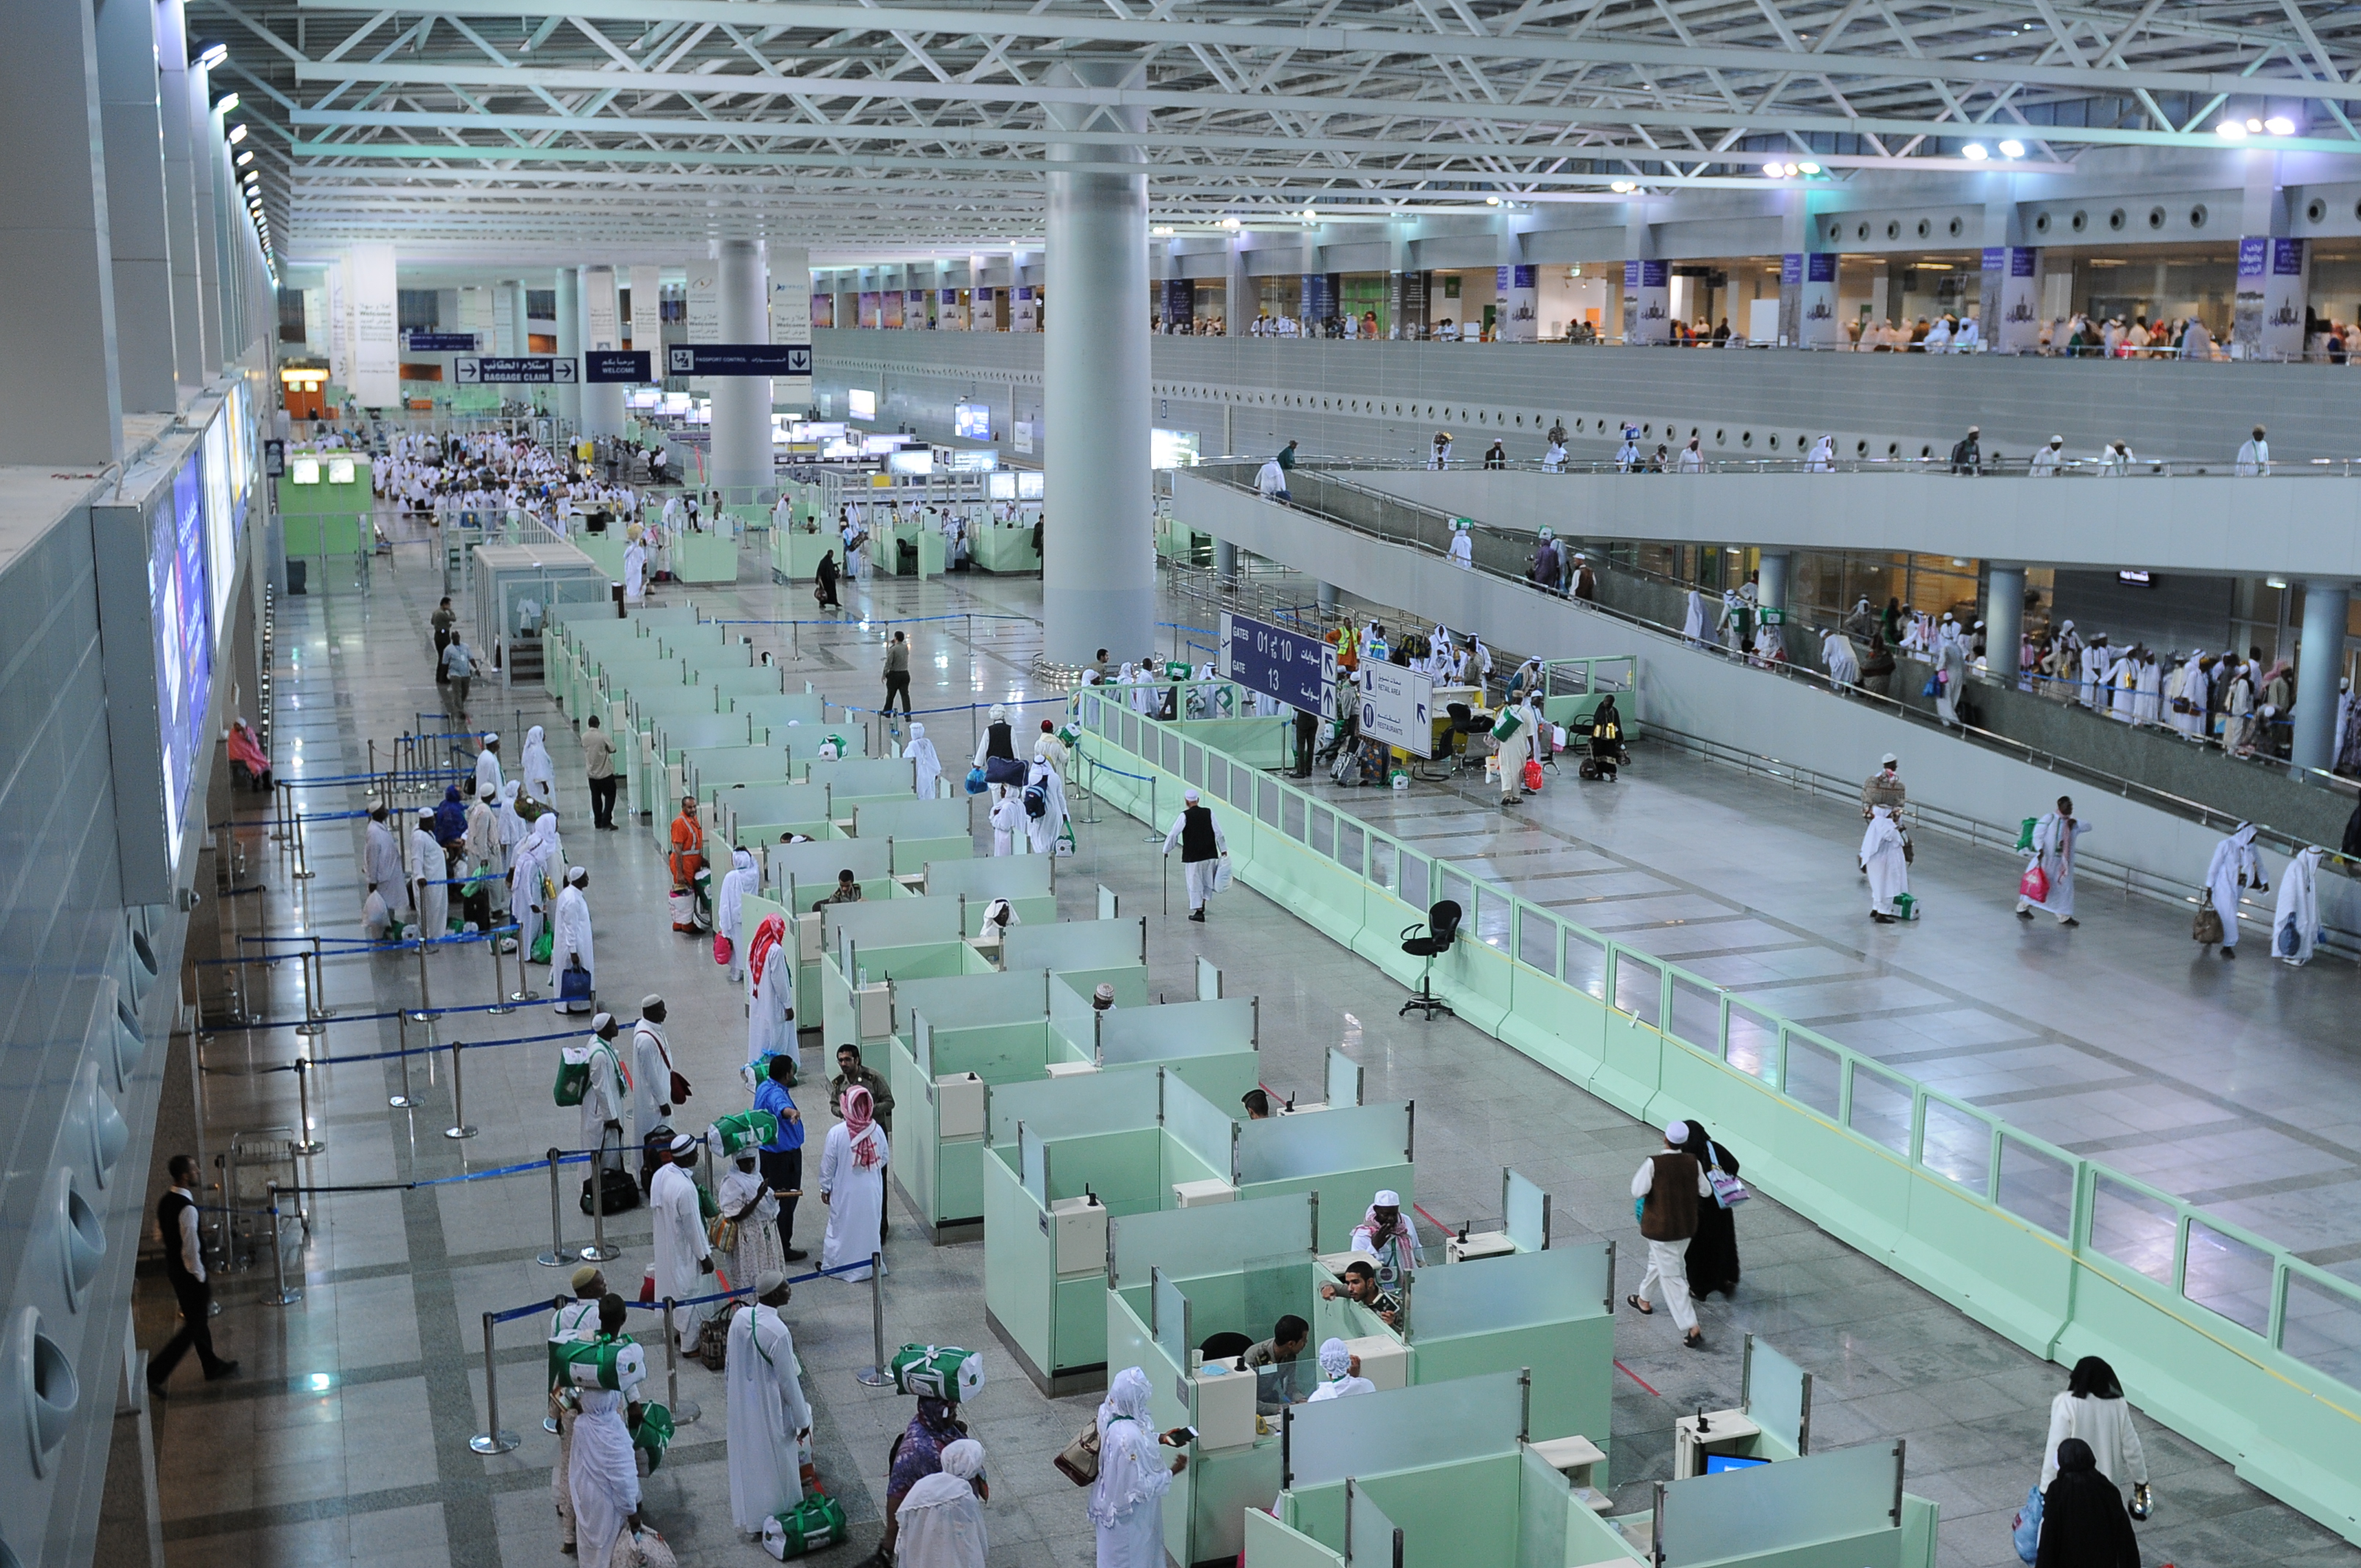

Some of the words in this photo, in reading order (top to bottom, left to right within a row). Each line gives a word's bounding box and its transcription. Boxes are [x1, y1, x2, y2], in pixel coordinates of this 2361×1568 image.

[483, 360, 520, 371] الحقائب
[521, 360, 549, 371] استلام
[601, 358, 615, 366] بكم
[484, 373, 521, 382] BAGGAGE
[523, 373, 550, 382] CLAIM
[1233, 625, 1249, 641] GATES
[1257, 631, 1268, 654] 01
[1270, 647, 1277, 659] To
[1280, 639, 1292, 662] 10
[1300, 649, 1321, 668] بوابات
[1232, 659, 1246, 675] GATE
[1268, 667, 1280, 691] 13
[1300, 682, 1320, 705] بوابة
[1378, 683, 1390, 694] RETAIL
[1390, 688, 1401, 696] AREA
[1377, 721, 1403, 736] RESTAURANTS
